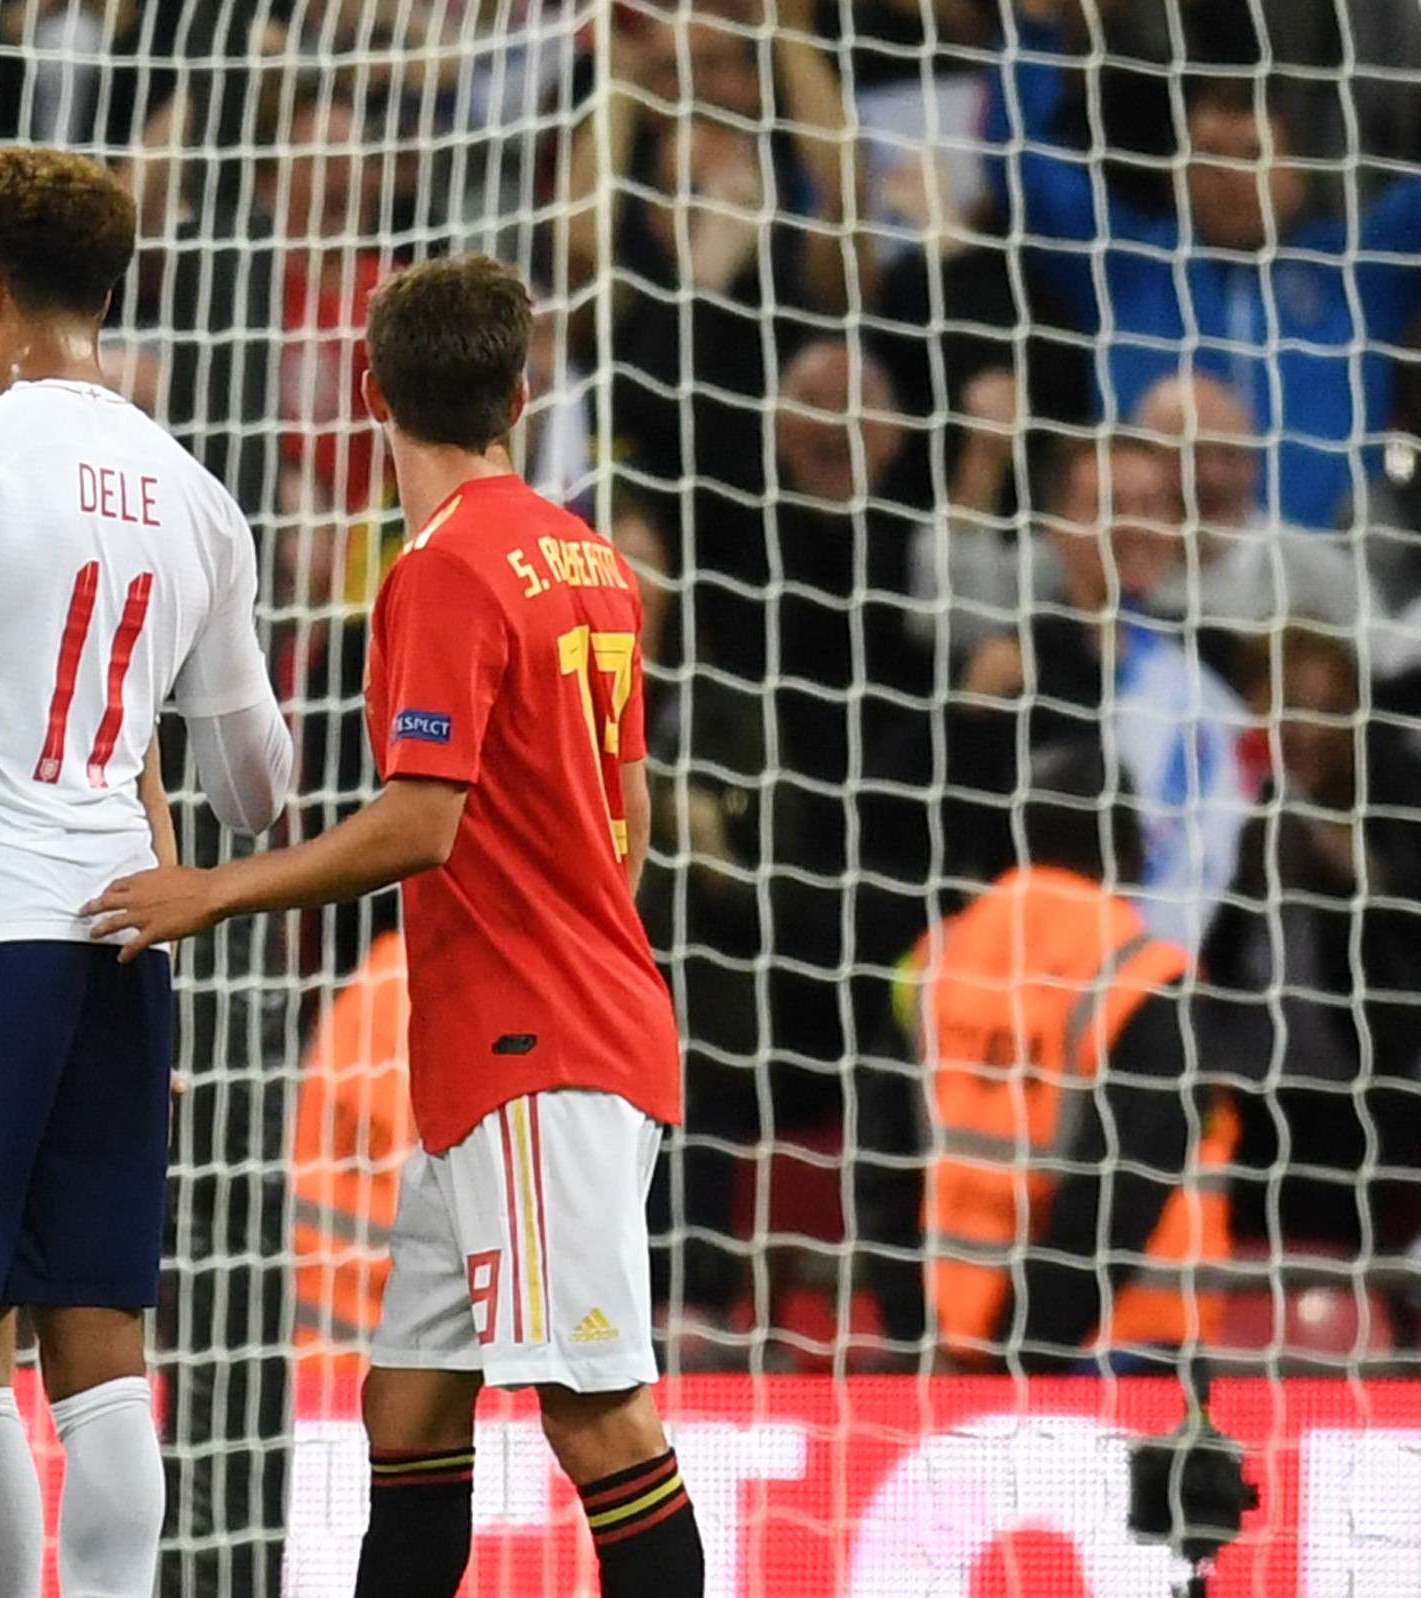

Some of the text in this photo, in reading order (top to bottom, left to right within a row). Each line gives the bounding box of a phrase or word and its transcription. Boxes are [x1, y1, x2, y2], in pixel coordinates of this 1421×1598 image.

[78, 462, 161, 527] DELE
[506, 547, 551, 599] S.
[32, 560, 154, 789] 11
[556, 624, 636, 864] 17
